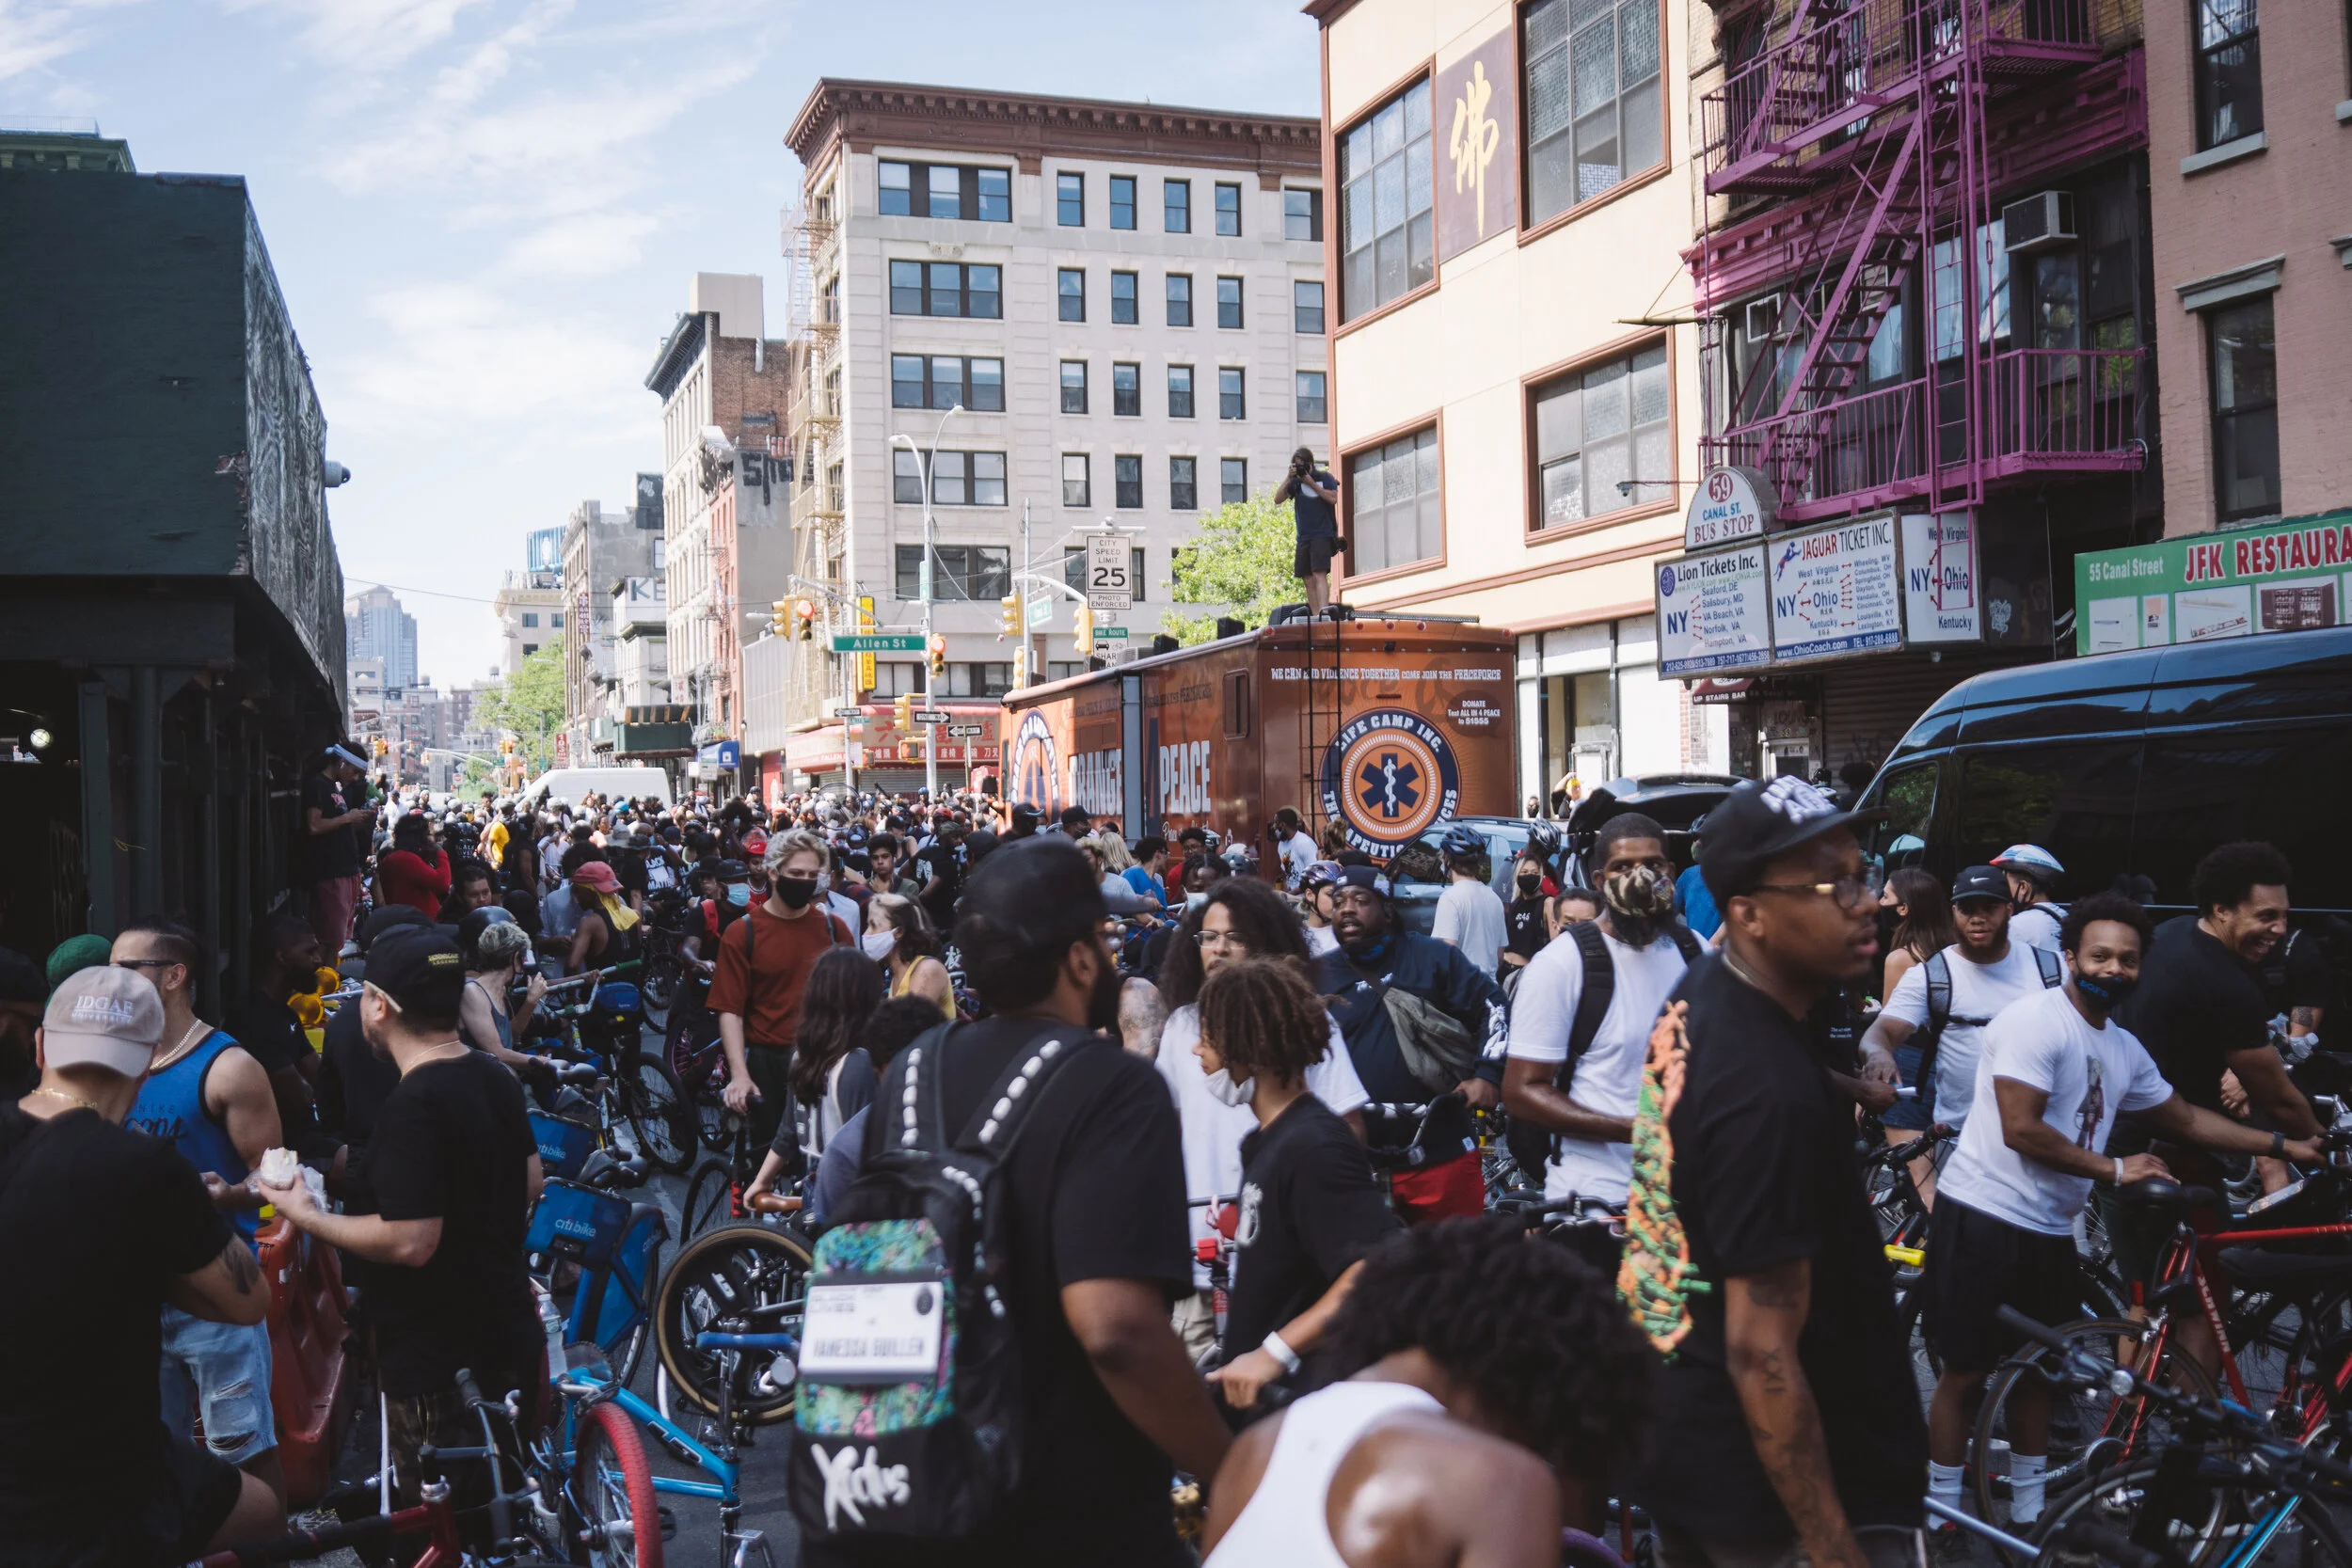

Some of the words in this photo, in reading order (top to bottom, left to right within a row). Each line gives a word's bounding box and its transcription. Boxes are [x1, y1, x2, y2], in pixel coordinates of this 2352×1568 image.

[1449, 60, 1501, 240] 佛
[1711, 475, 1729, 500] 59
[1703, 506, 1727, 521] CANAL
[1730, 501, 1741, 515] ST.
[1694, 523, 1716, 543] BUS
[1723, 514, 1755, 537] STOP
[1928, 527, 1943, 541] Wet
[1947, 527, 1969, 543] Virgini
[1802, 533, 1838, 561] JAGUAR
[1839, 526, 1869, 553] TICKET
[1872, 522, 1892, 546] INC.
[2184, 541, 2226, 584] JFK
[2234, 522, 2352, 578] RESTAURA
[1093, 566, 1126, 587] 25
[1677, 565, 1698, 582] Lion
[1700, 558, 1737, 578] Tickets
[1739, 553, 1758, 570] Inc.
[1797, 569, 1813, 579] West
[1816, 563, 1839, 576] Virginia
[2089, 562, 2102, 582] 55
[2103, 560, 2130, 580] Canal
[2132, 556, 2164, 578] Street
[1729, 581, 1739, 591] DE
[1911, 568, 1931, 592] NY
[1945, 566, 1969, 591] Ohio
[1733, 593, 1744, 603] MD
[1777, 594, 1796, 618] NY
[1813, 590, 1838, 608] Ohio
[1667, 610, 1688, 634] NY
[1703, 612, 1711, 621] VA
[1735, 607, 1744, 616] VA
[1731, 621, 1741, 630] VA
[1809, 619, 1837, 629] Kentucky
[1938, 614, 1972, 631] Kentucky
[853, 639, 889, 648] Allen
[893, 639, 907, 648] St
[1738, 634, 1747, 643] VA
[1776, 641, 1848, 657] www.OhioCoach.com
[1271, 668, 1283, 680] WE
[1284, 668, 1301, 680] CAN
[1360, 668, 1400, 680] TOGETHER
[1401, 671, 1421, 679] COME
[1422, 671, 1438, 679] JOIN
[1438, 671, 1453, 679] THE
[1454, 669, 1502, 680] PEACEFORCE
[1706, 693, 1729, 702] STAIRS
[1335, 720, 1368, 752] LIFE
[1370, 714, 1415, 730] CAMP
[1417, 723, 1442, 752] INC.
[1069, 748, 1122, 816] ORANGE
[1159, 739, 1211, 816] PEACE
[76, 995, 134, 1015] IDGAF
[138, 1103, 176, 1114] NIKE
[2195, 1275, 2232, 1354] SCHWINN
